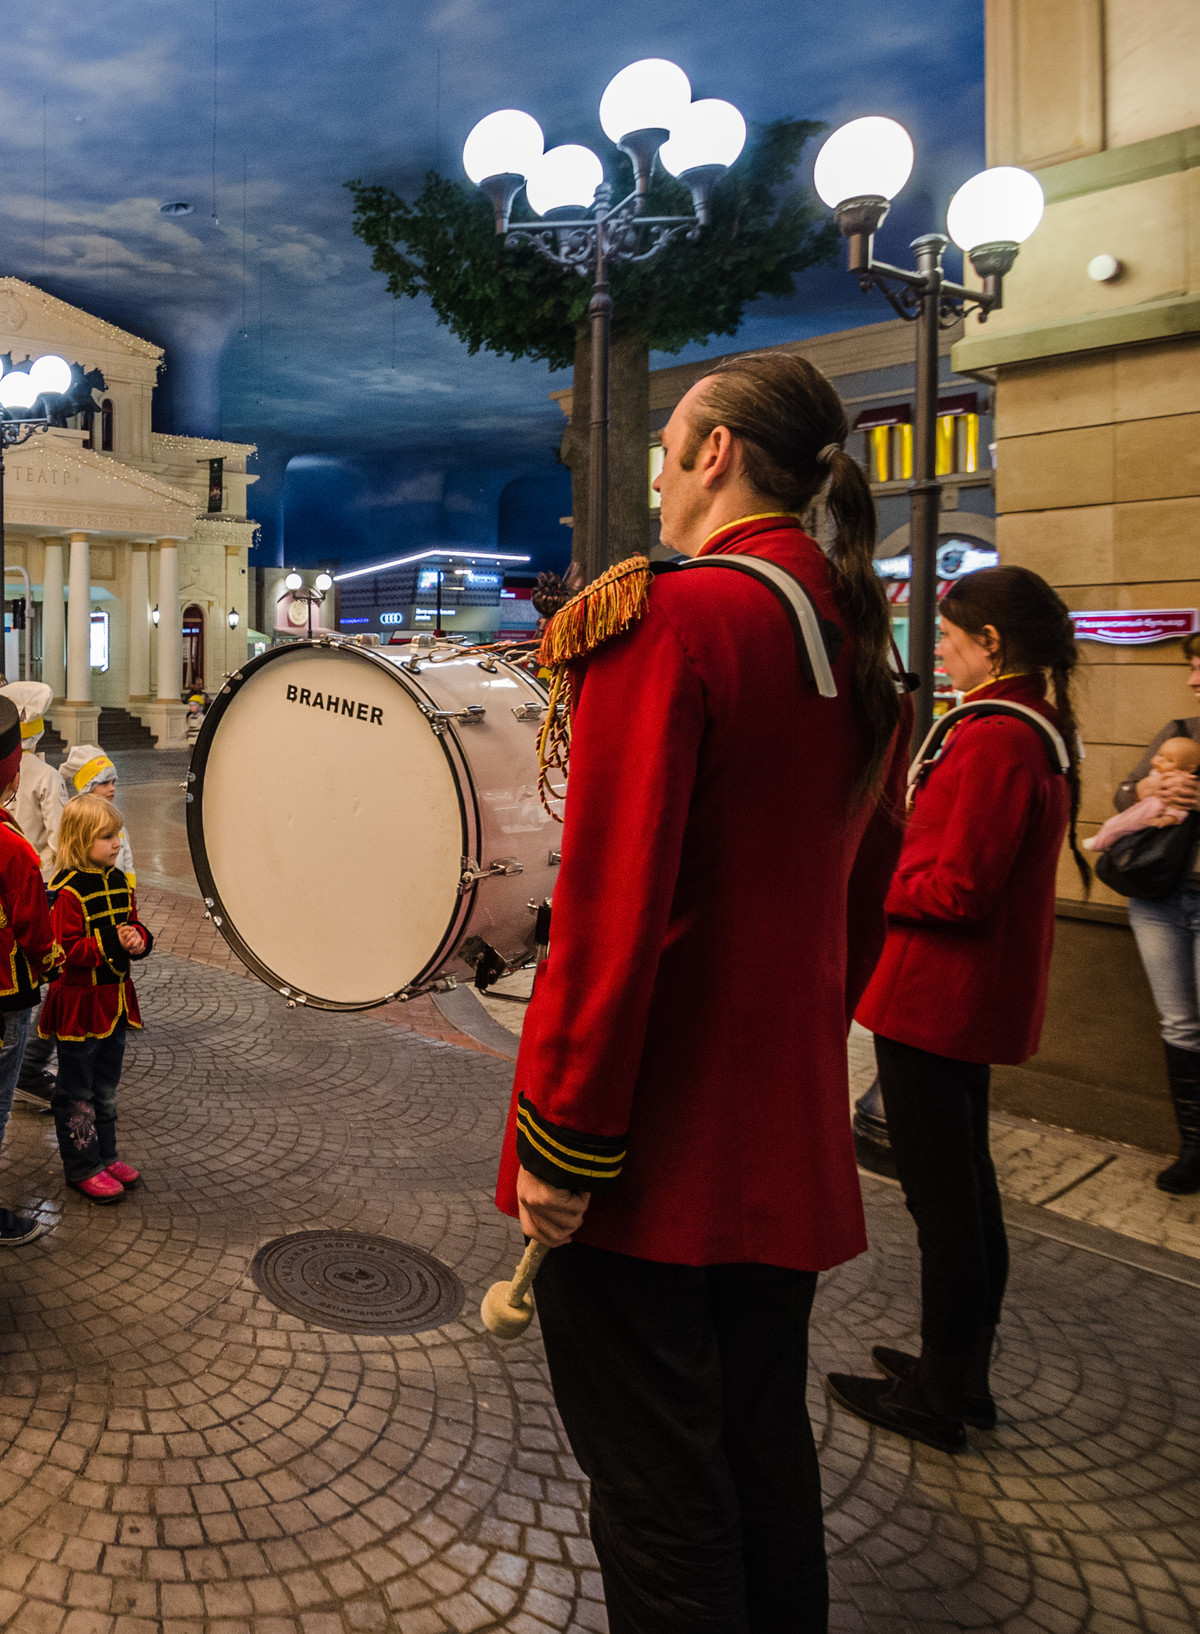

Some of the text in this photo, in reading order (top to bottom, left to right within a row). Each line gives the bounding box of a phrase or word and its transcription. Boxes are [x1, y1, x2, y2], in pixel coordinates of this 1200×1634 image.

[12, 465, 71, 485] ТЕАТР
[286, 684, 384, 725] BRAHNER
[323, 1242, 385, 1254] МОСКВА
